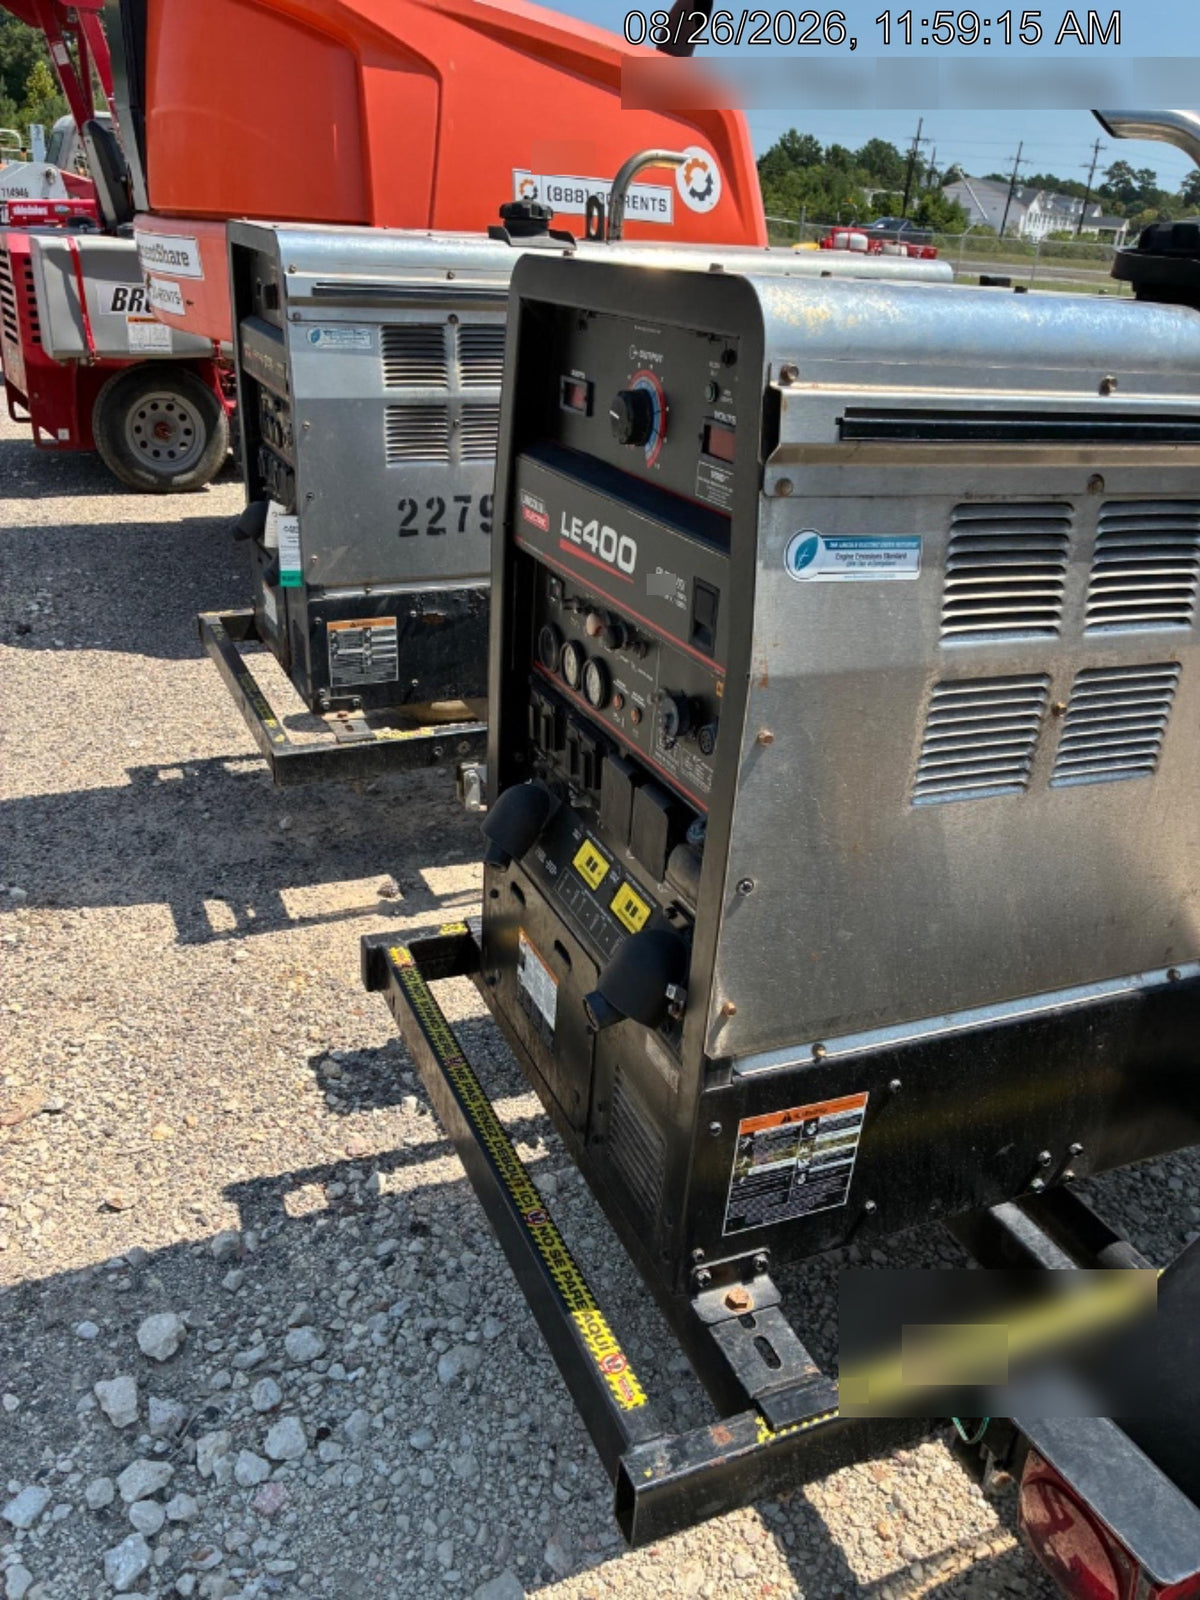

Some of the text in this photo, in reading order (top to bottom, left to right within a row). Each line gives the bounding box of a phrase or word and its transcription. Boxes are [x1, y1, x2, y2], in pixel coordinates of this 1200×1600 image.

[713, 410, 737, 426] VOLTS
[560, 511, 638, 575] LE400
[455, 1066, 536, 1209] NE PAS TENEZ DEBOUT ICI
[537, 1224, 556, 1248] NO
[549, 1246, 567, 1270] SE
[559, 1267, 590, 1312] PARE
